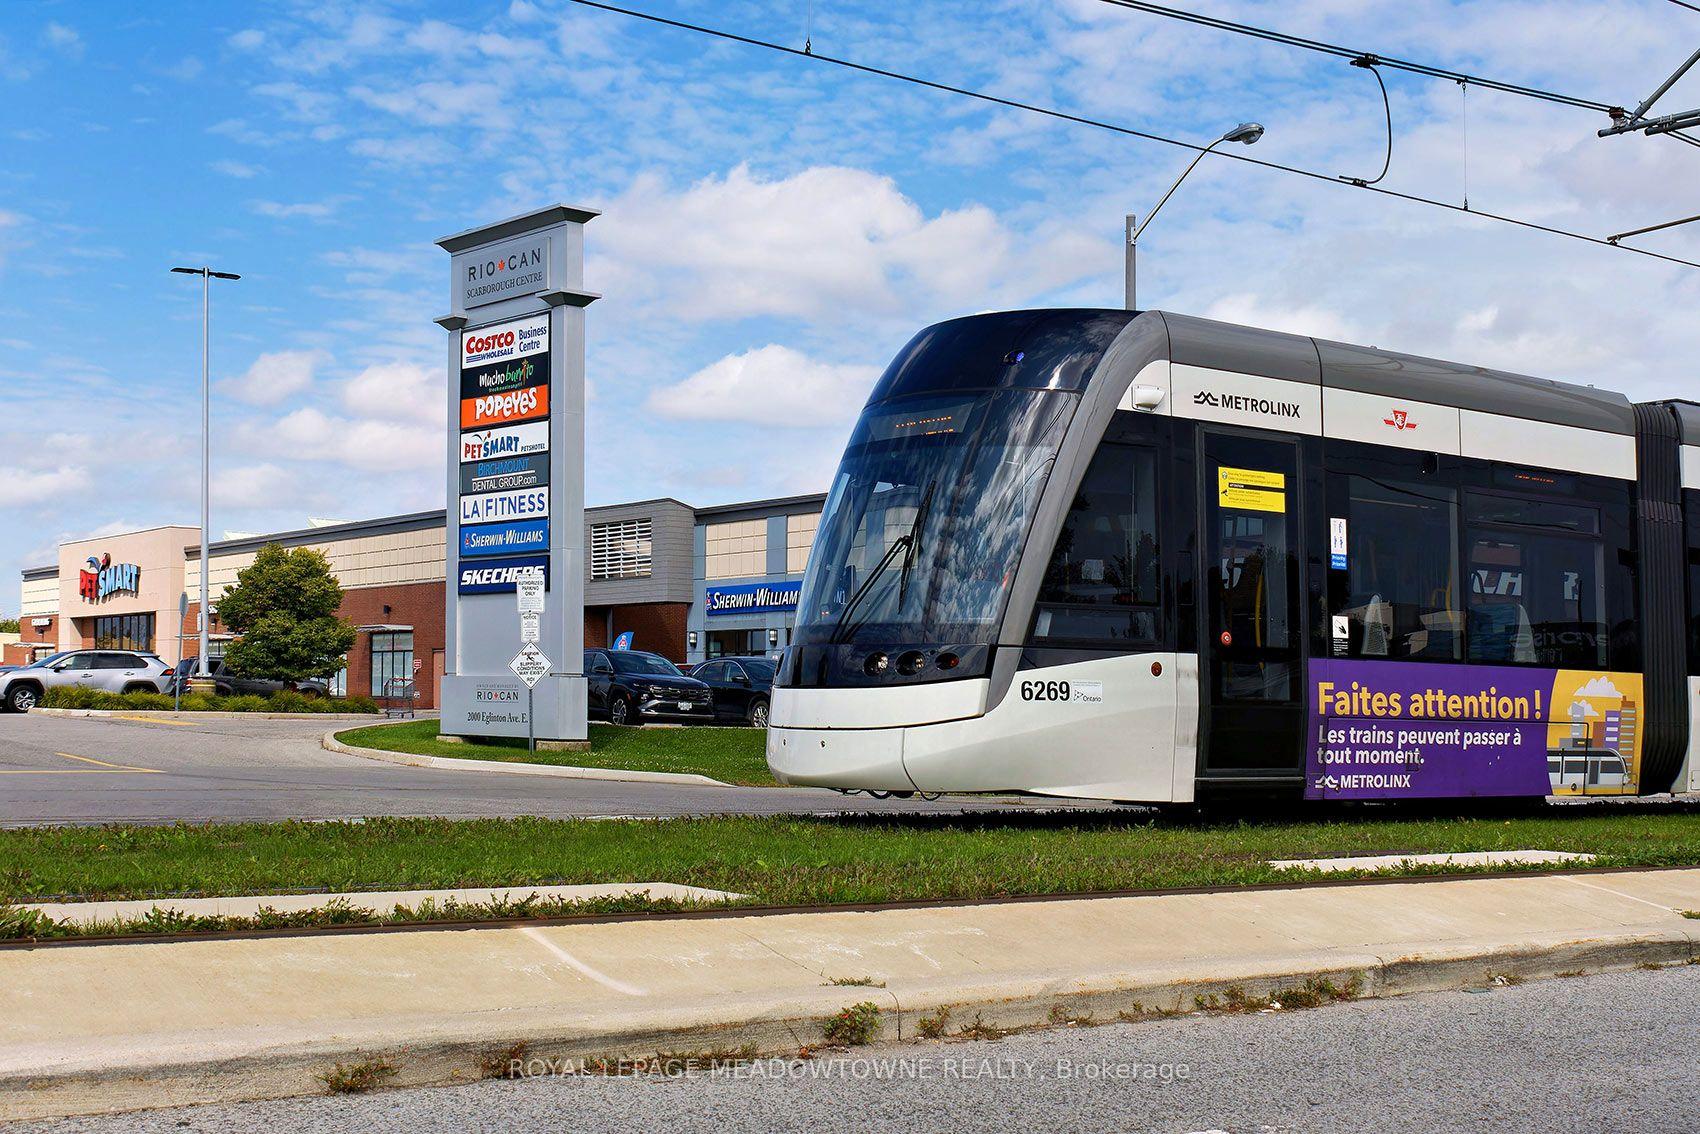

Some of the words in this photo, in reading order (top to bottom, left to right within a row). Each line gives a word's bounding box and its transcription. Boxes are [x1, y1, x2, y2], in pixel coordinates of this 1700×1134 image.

[468, 261, 495, 282] RIO
[508, 247, 541, 271] CAN
[467, 281, 515, 299] SCARBOROUGH
[515, 271, 543, 286] CENTRE
[466, 331, 515, 354] COSTCO
[518, 326, 547, 340] Business
[480, 348, 514, 361] WHOLESALE
[518, 340, 541, 352] Centre
[1221, 394, 1301, 418] METROLINX
[478, 458, 529, 477] BIRCHMOUNT
[472, 479, 498, 491] DENTAL
[463, 500, 480, 519] LA
[486, 493, 545, 517] FITNESS
[712, 587, 801, 610] SHERWIN-WILLIAM
[476, 691, 493, 700] RIO
[499, 691, 519, 700] CAN
[1020, 680, 1071, 702] 6269
[1317, 681, 1402, 717] Faites
[1409, 686, 1529, 719] attention
[1318, 725, 1346, 744] Les
[1349, 724, 1394, 744] trains
[1397, 729, 1460, 749] peuvent
[1463, 731, 1511, 750] passer
[1512, 728, 1522, 746] à
[1317, 747, 1351, 764] tout
[1355, 749, 1425, 765] moment.
[1340, 774, 1411, 789] METROLINX
